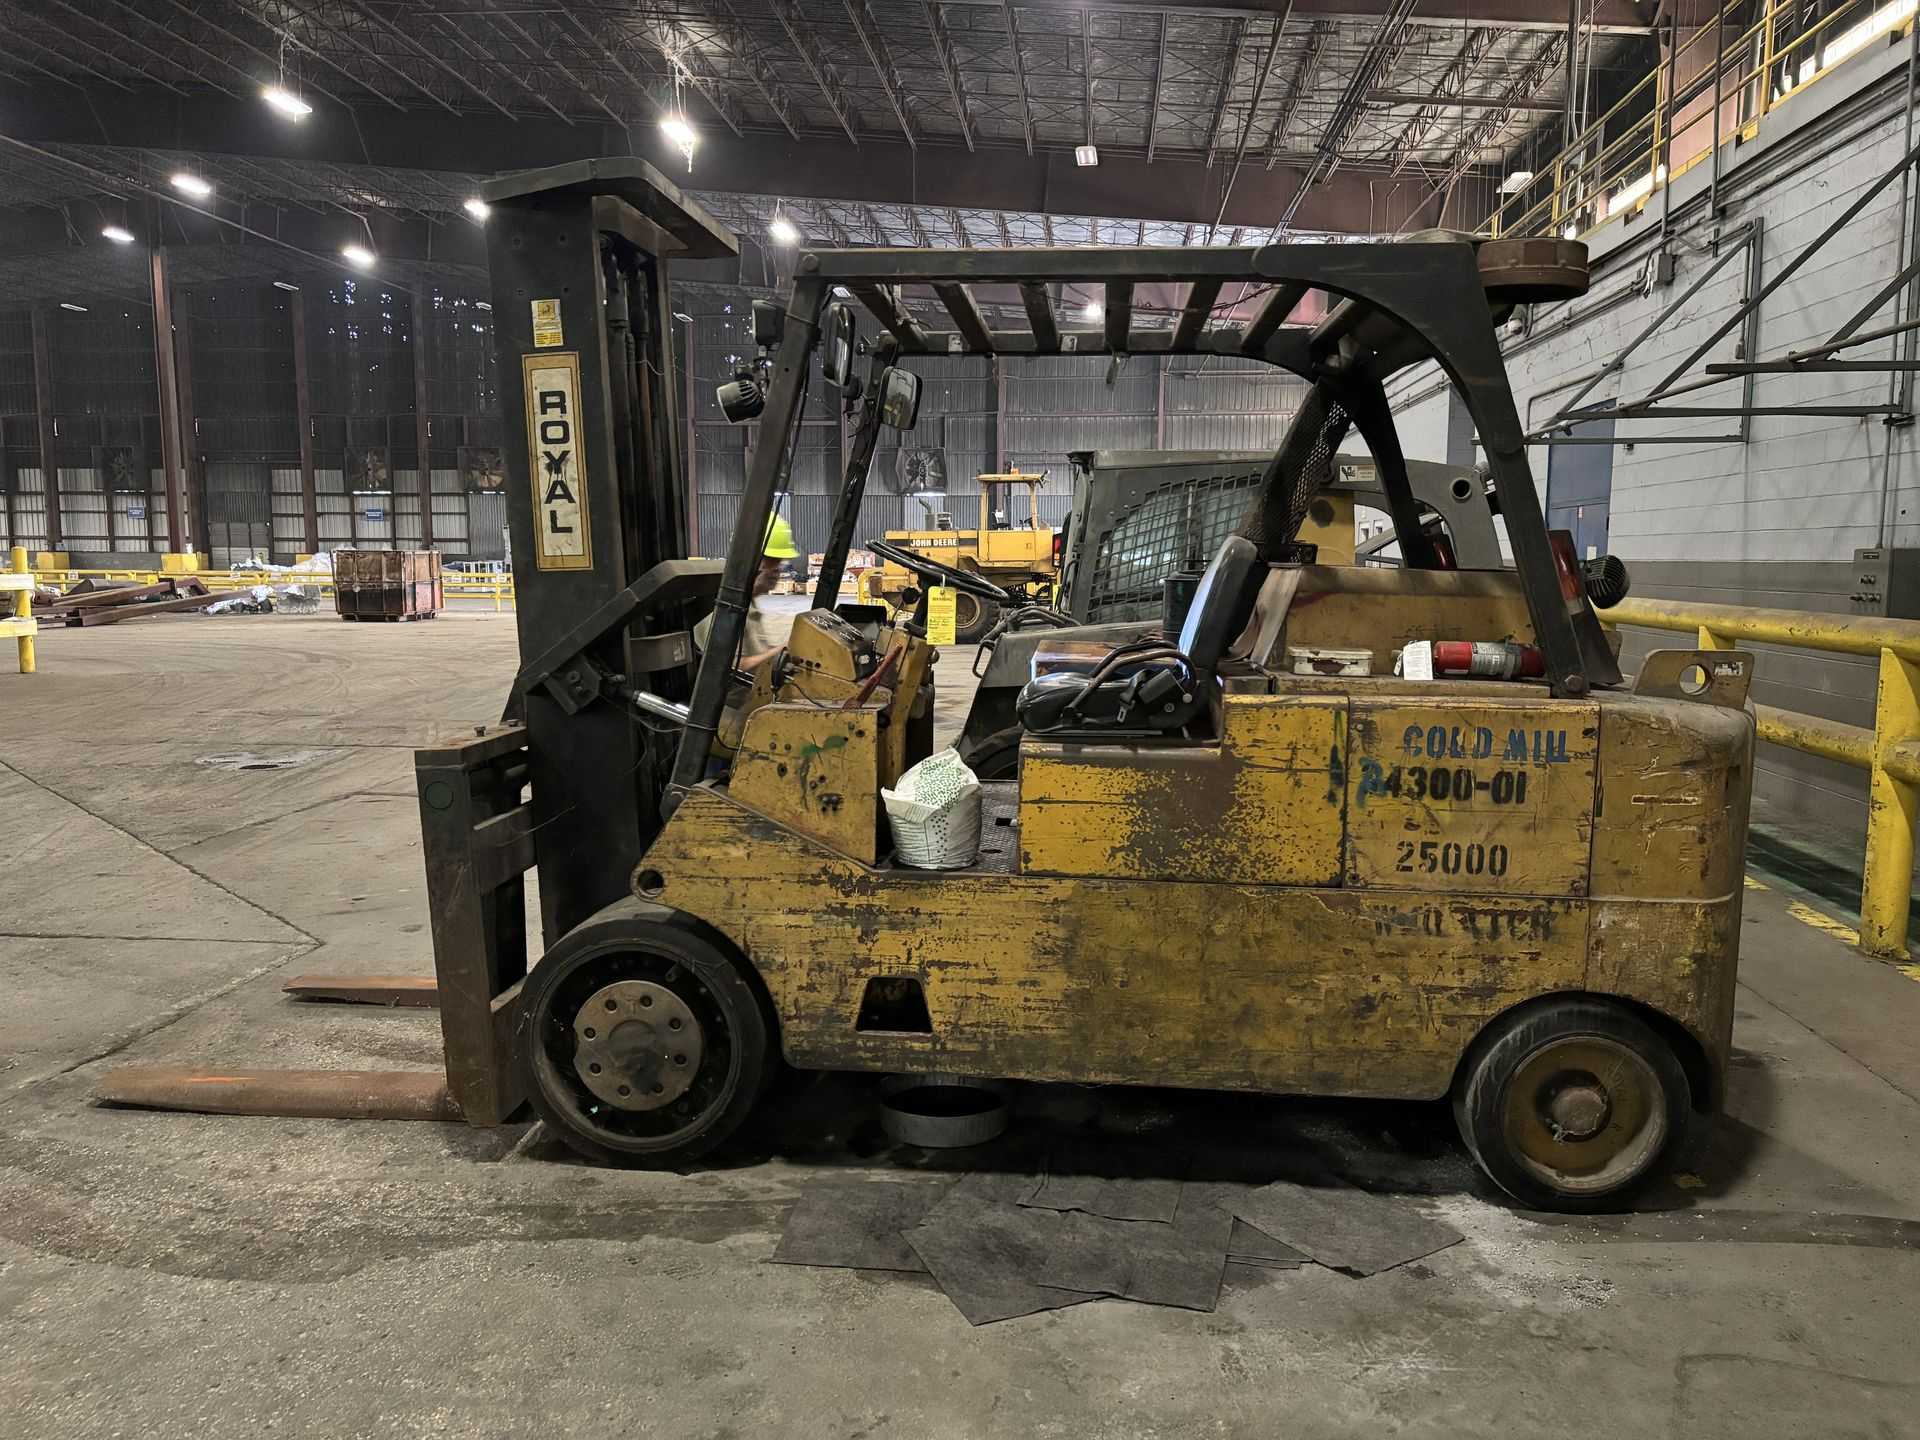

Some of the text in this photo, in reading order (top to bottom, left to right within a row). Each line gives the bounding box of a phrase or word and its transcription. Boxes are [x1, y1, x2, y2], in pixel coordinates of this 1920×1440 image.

[539, 390, 576, 534] ROYAL
[910, 538, 958, 547] JOHN DEERE
[1403, 724, 1570, 766] COLD MILL
[1396, 840, 1508, 876] 25000
